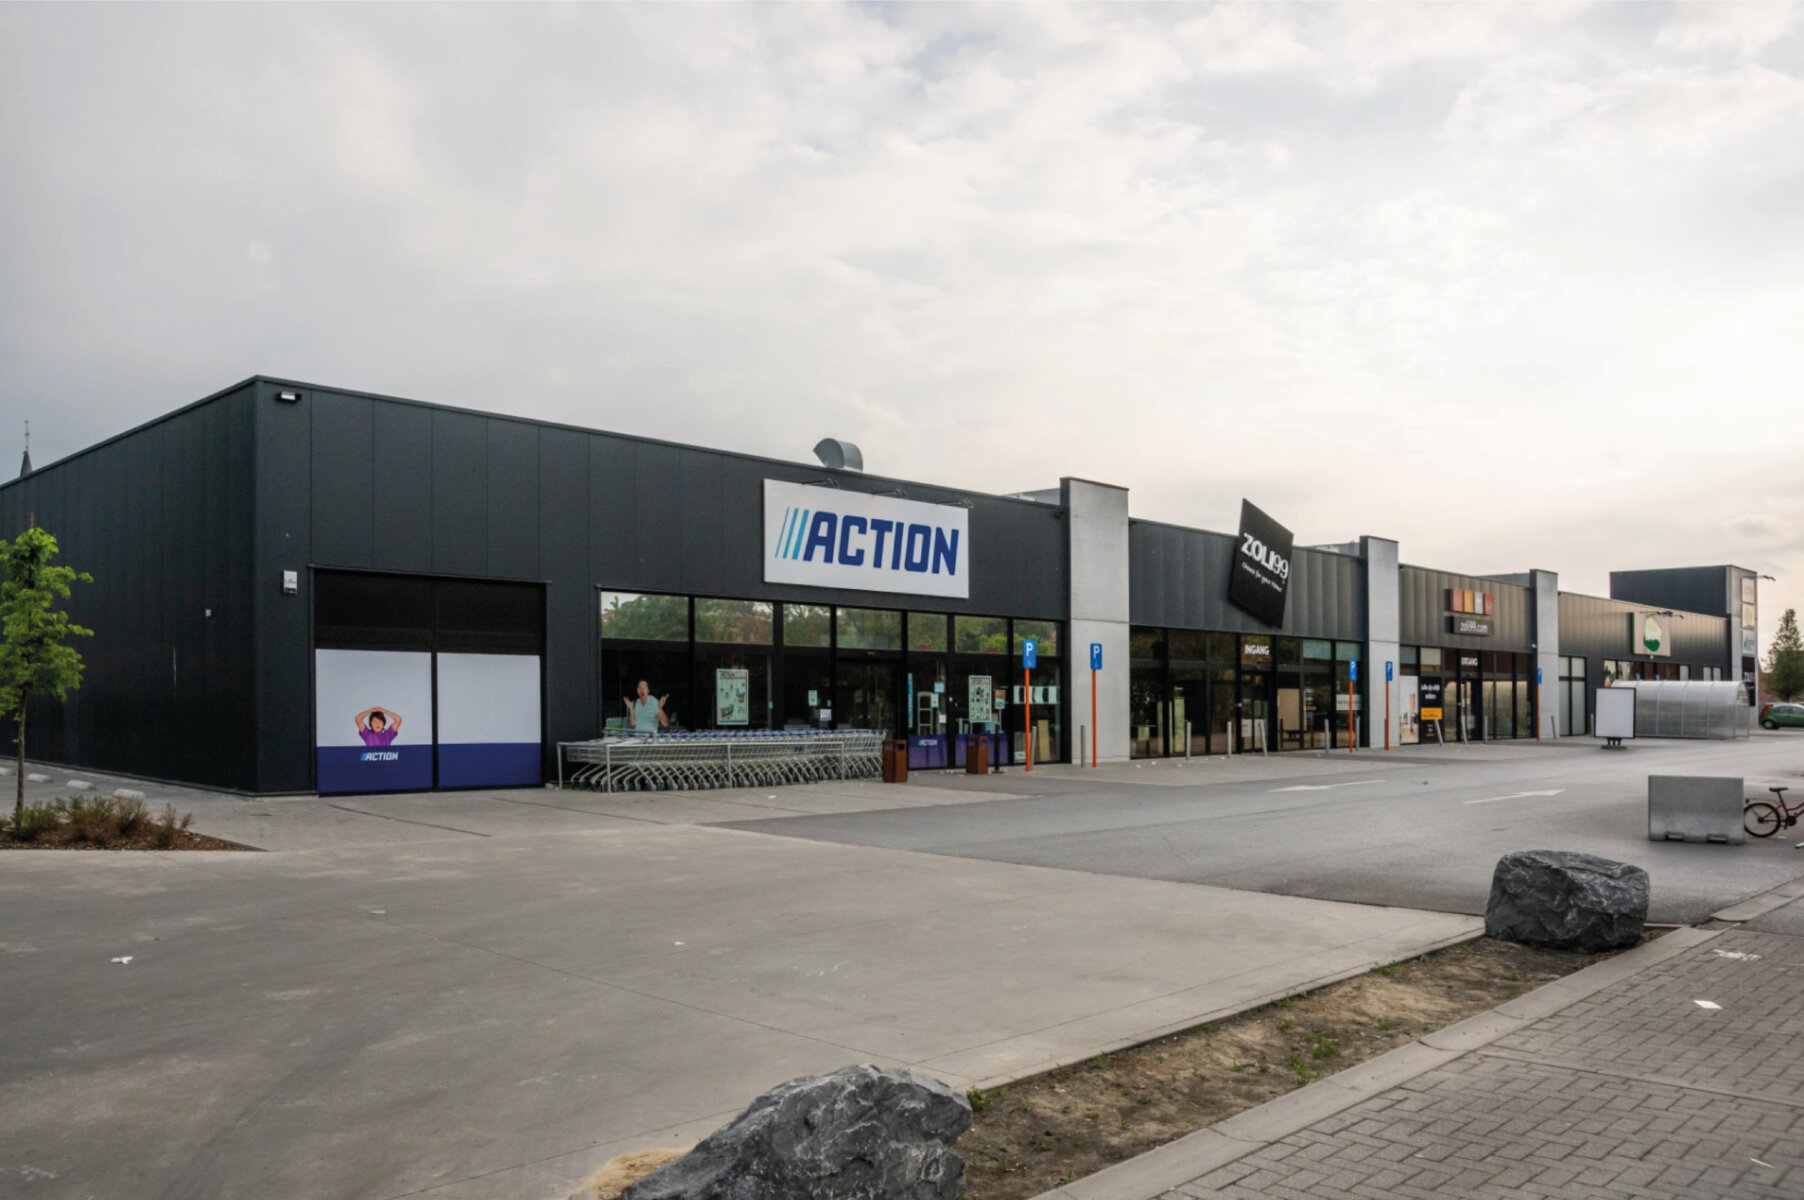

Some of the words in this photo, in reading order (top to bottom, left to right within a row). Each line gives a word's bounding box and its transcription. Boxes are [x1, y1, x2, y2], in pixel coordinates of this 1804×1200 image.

[803, 511, 959, 576] ACTION
[1026, 642, 1034, 657] P
[1093, 645, 1100, 659] P
[1244, 643, 1270, 655] INGANG
[1350, 661, 1356, 672] P
[365, 752, 399, 761] ACTION
